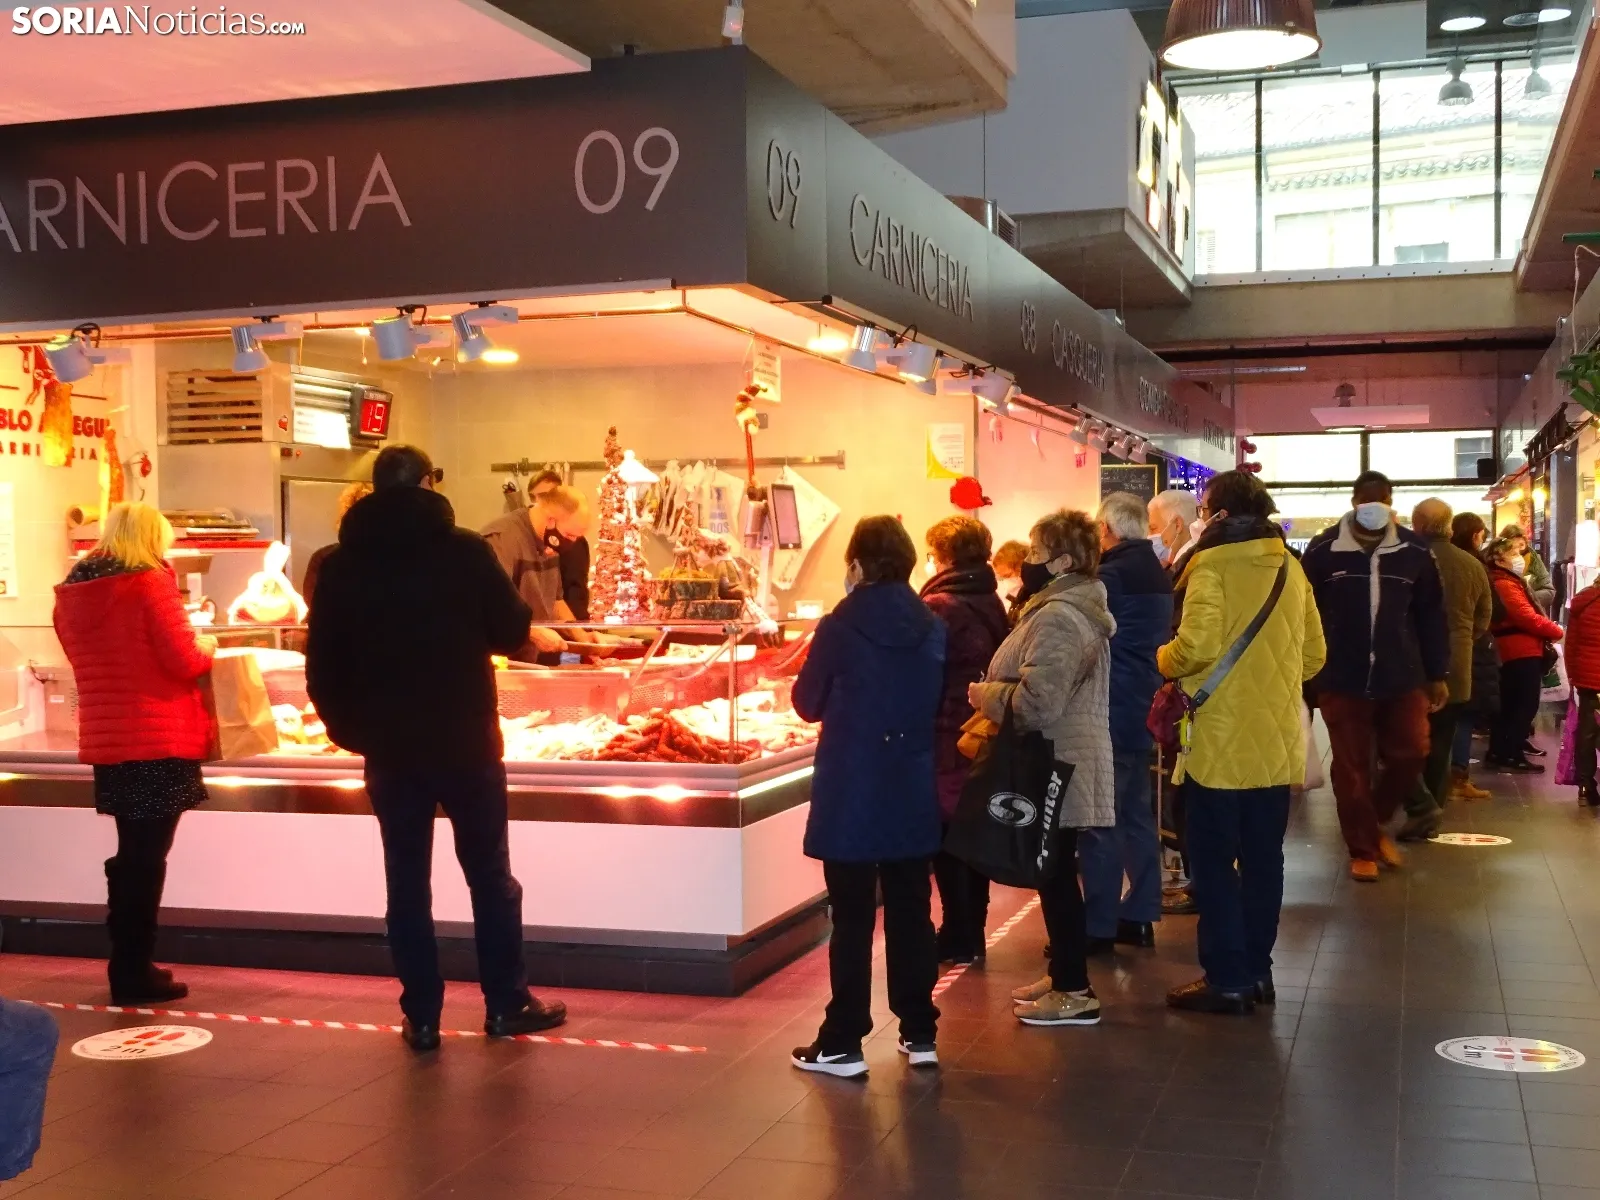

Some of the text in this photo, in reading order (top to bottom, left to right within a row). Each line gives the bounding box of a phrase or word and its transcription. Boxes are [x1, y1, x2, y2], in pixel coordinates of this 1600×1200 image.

[574, 127, 680, 214] 09
[767, 138, 974, 322] 09 CARNICERIA
[1020, 299, 1107, 392] 08 CASQUERIA
[367, 403, 386, 432] 19
